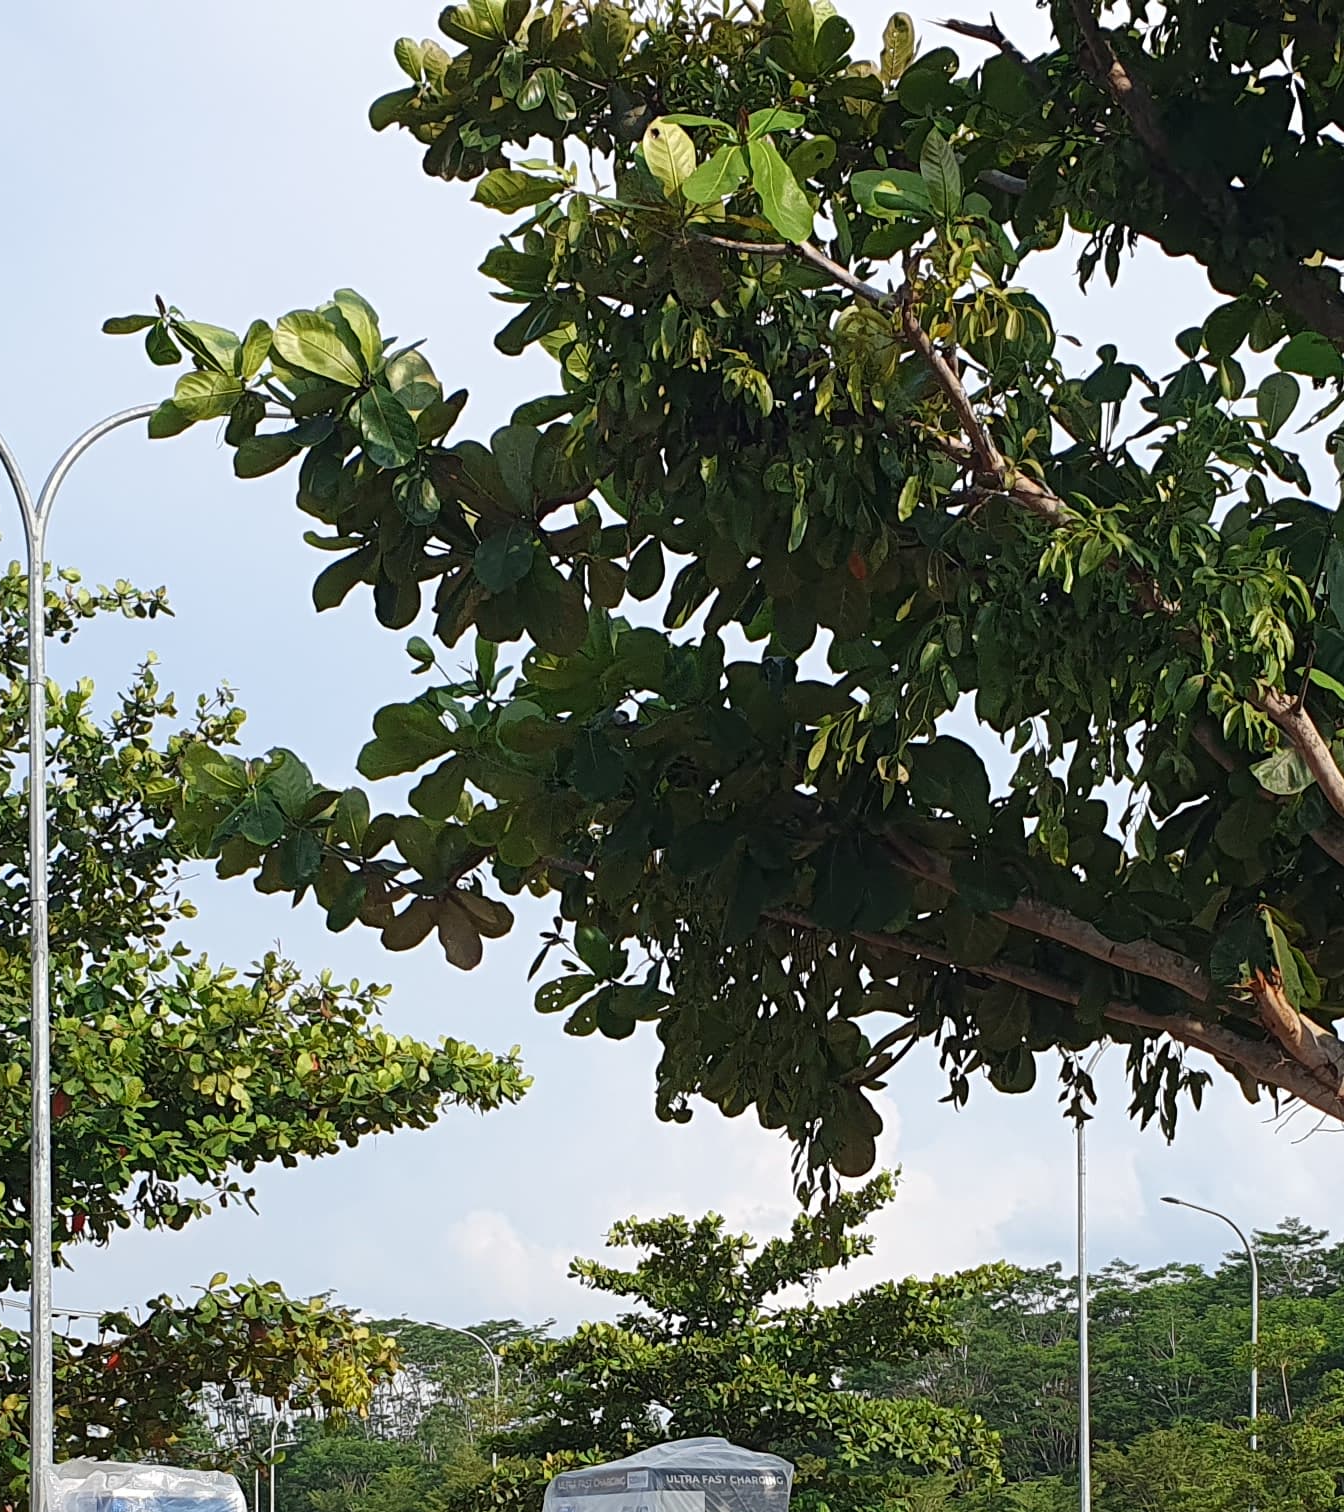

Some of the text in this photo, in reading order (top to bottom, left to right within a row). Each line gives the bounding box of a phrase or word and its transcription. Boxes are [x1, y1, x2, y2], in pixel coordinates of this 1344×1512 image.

[666, 1474, 784, 1486] ULTRA FAST CHARGING
